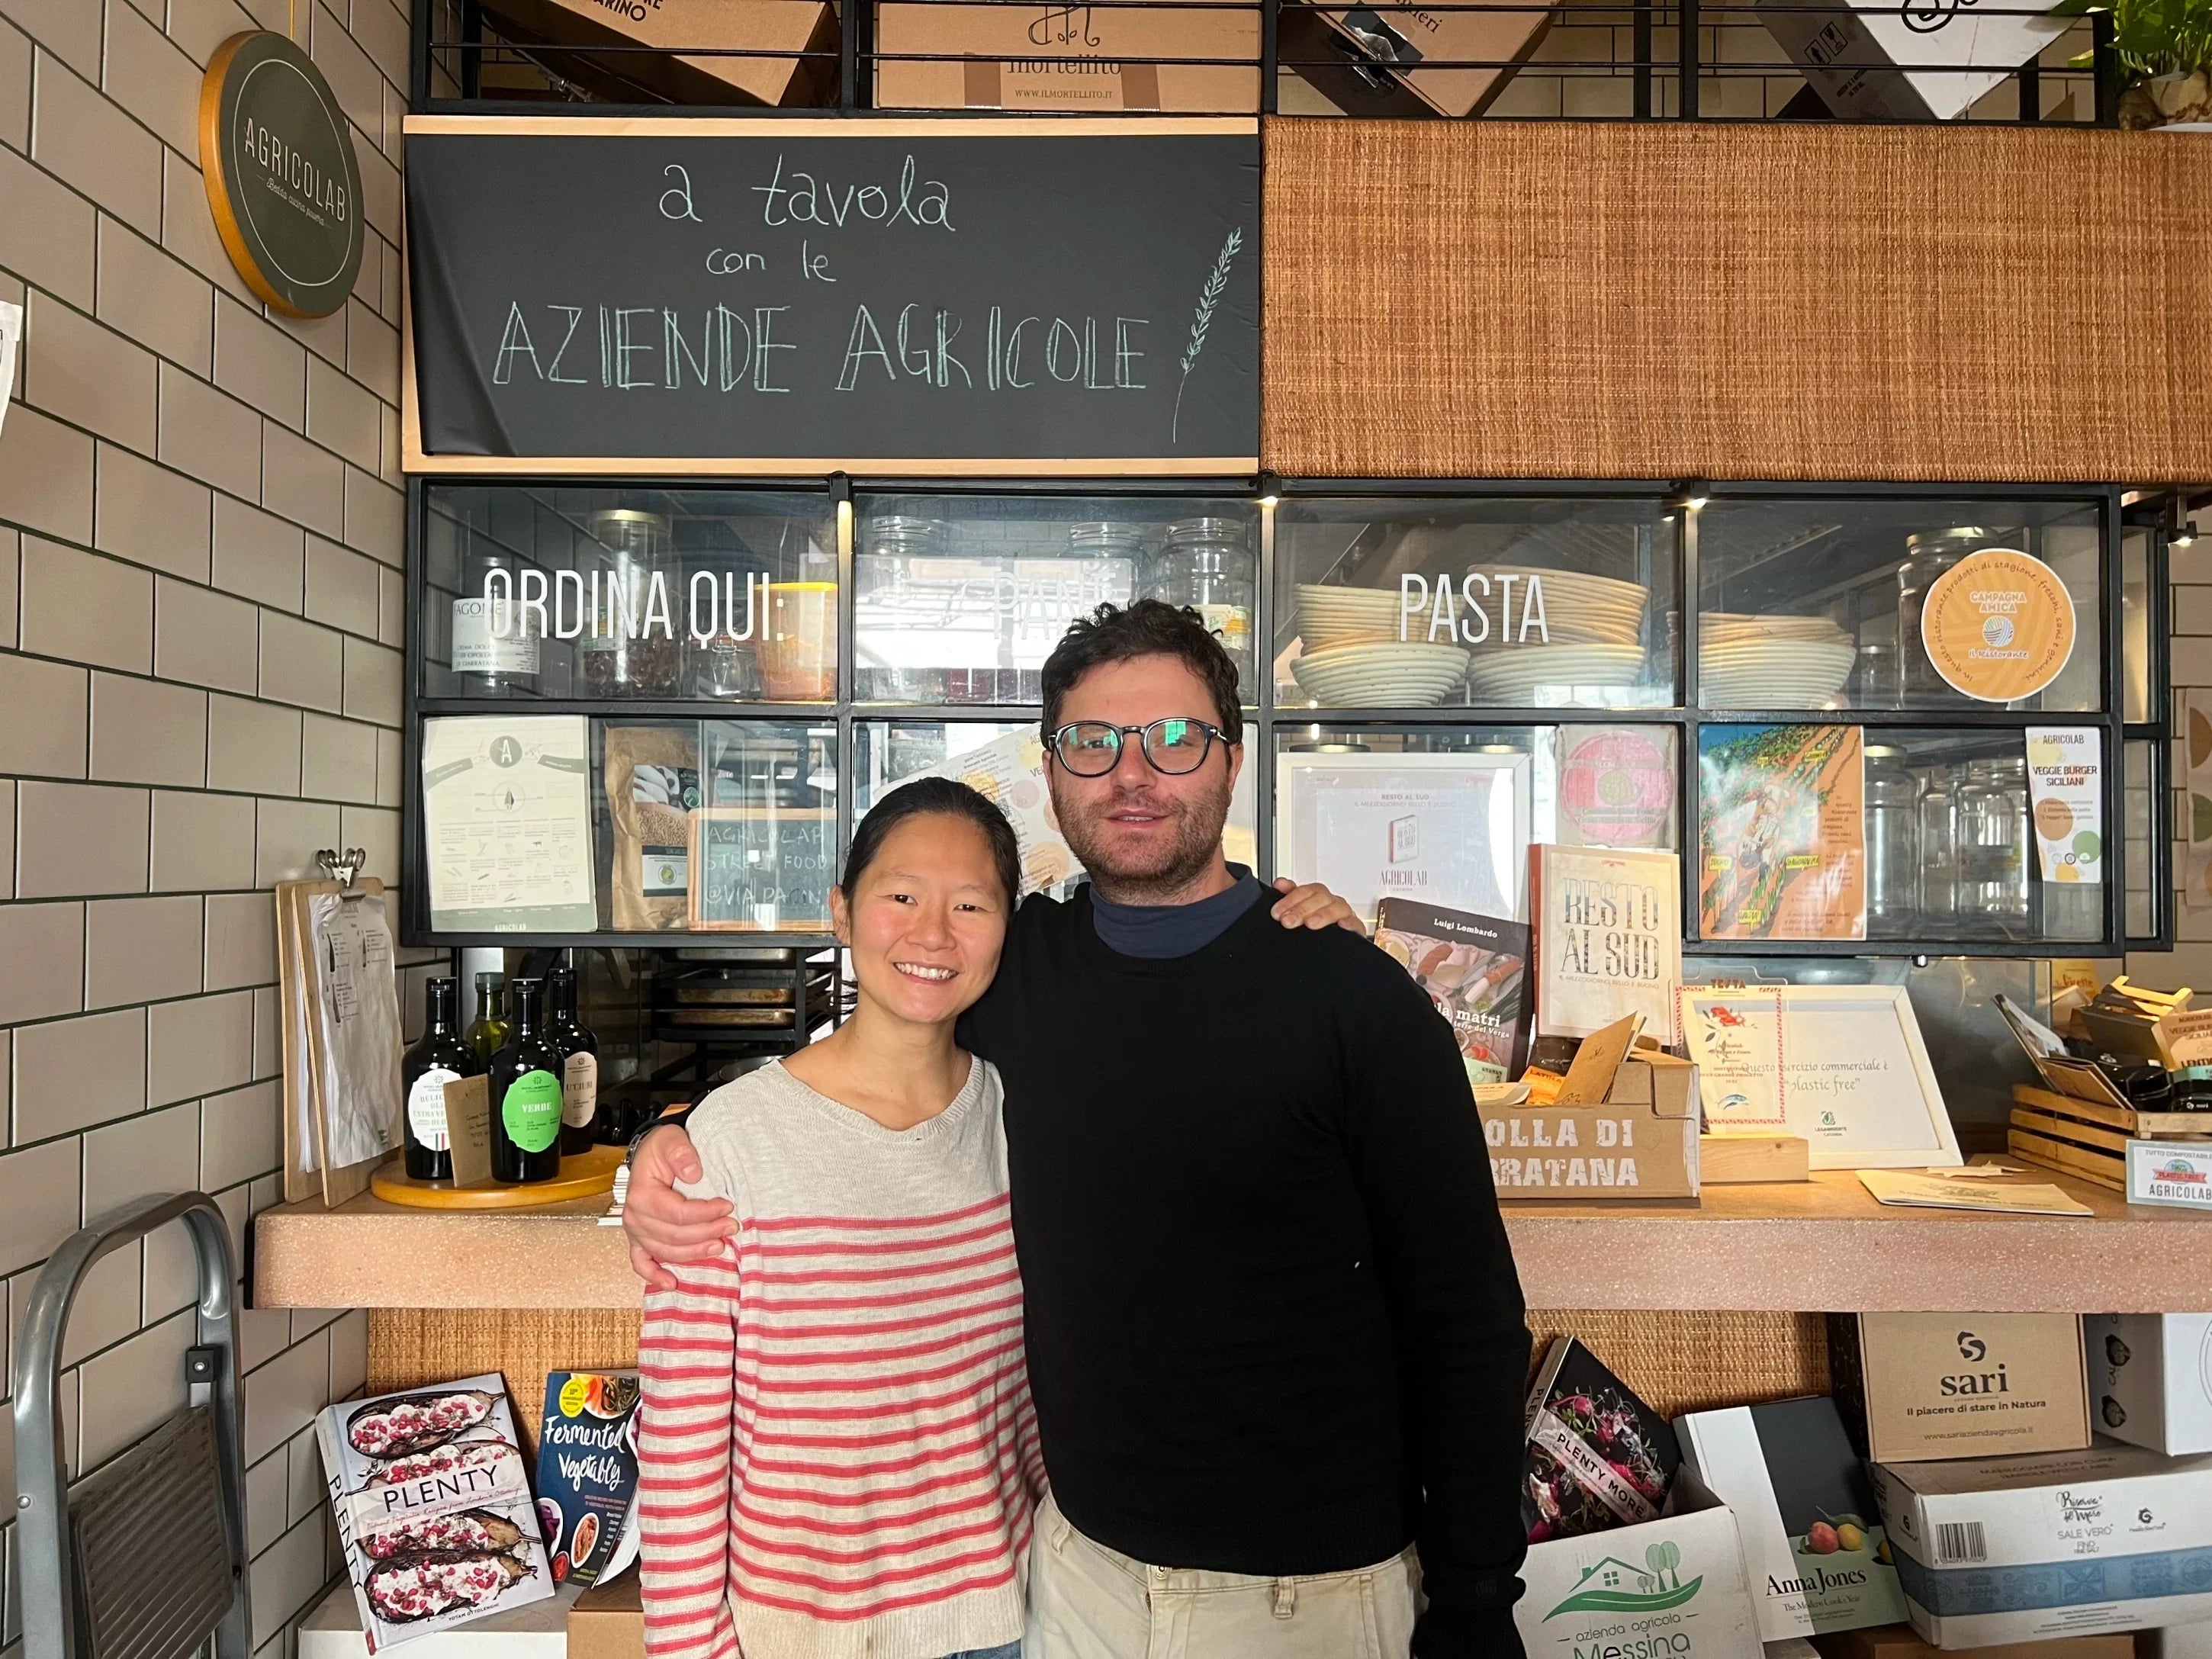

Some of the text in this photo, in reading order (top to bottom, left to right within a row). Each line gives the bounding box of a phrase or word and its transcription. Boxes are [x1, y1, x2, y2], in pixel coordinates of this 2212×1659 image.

[244, 117, 346, 221] AGRICOLAB
[660, 154, 956, 232] a tavola
[706, 240, 837, 282] con le
[492, 301, 1149, 392] AZIENDE AGRICOLE
[484, 567, 784, 650] ORDINA QUI:
[1400, 573, 1550, 644] PASTA
[1933, 593, 1950, 643] ristorante
[1946, 564, 1979, 594] prodotti
[1981, 559, 1991, 571] di
[1970, 592, 2027, 603] CAMPAGNA
[1979, 603, 2017, 613] AMICA
[2043, 735, 2084, 744] AGRICOLAB
[2033, 765, 2098, 776] VEGGIE BURGER
[2046, 777, 2084, 786] SICILIANI
[708, 826, 825, 844] AGRICLAB
[785, 854, 828, 870] FOOD
[1379, 870, 1428, 886] AGRICOLAB
[1564, 877, 1660, 931] RESTO
[1433, 918, 1498, 939] Luigi Lombardo
[1560, 928, 1599, 976] AL
[1605, 931, 1660, 981] SUD
[1711, 979, 1747, 989] TESTA
[1456, 1009, 1501, 1028] matri
[1488, 1027, 1510, 1039] Verga
[1821, 1058, 1880, 1072] commerciale
[522, 1101, 552, 1114] VERDE
[1596, 1119, 1633, 1147] DI
[2149, 1184, 2212, 1201] AGRICOLAB
[1940, 1363, 2010, 1397] sari
[1525, 1388, 1545, 1429] PLEN
[1916, 1406, 1955, 1417] piacere
[1957, 1404, 1967, 1413] di
[1969, 1403, 1995, 1412] stare
[1998, 1401, 2009, 1410] in
[2011, 1400, 2046, 1410] Natura
[545, 1416, 626, 1453] Fermented
[384, 1464, 497, 1513] PLENTY
[1557, 1432, 1645, 1519] PLENTY MORE
[330, 1474, 363, 1589] PLENTY
[2057, 1526, 2112, 1539] SALE VERO
[1766, 1567, 1866, 1596] Anna Jones
[1576, 1612, 1682, 1642] azienda agricola
